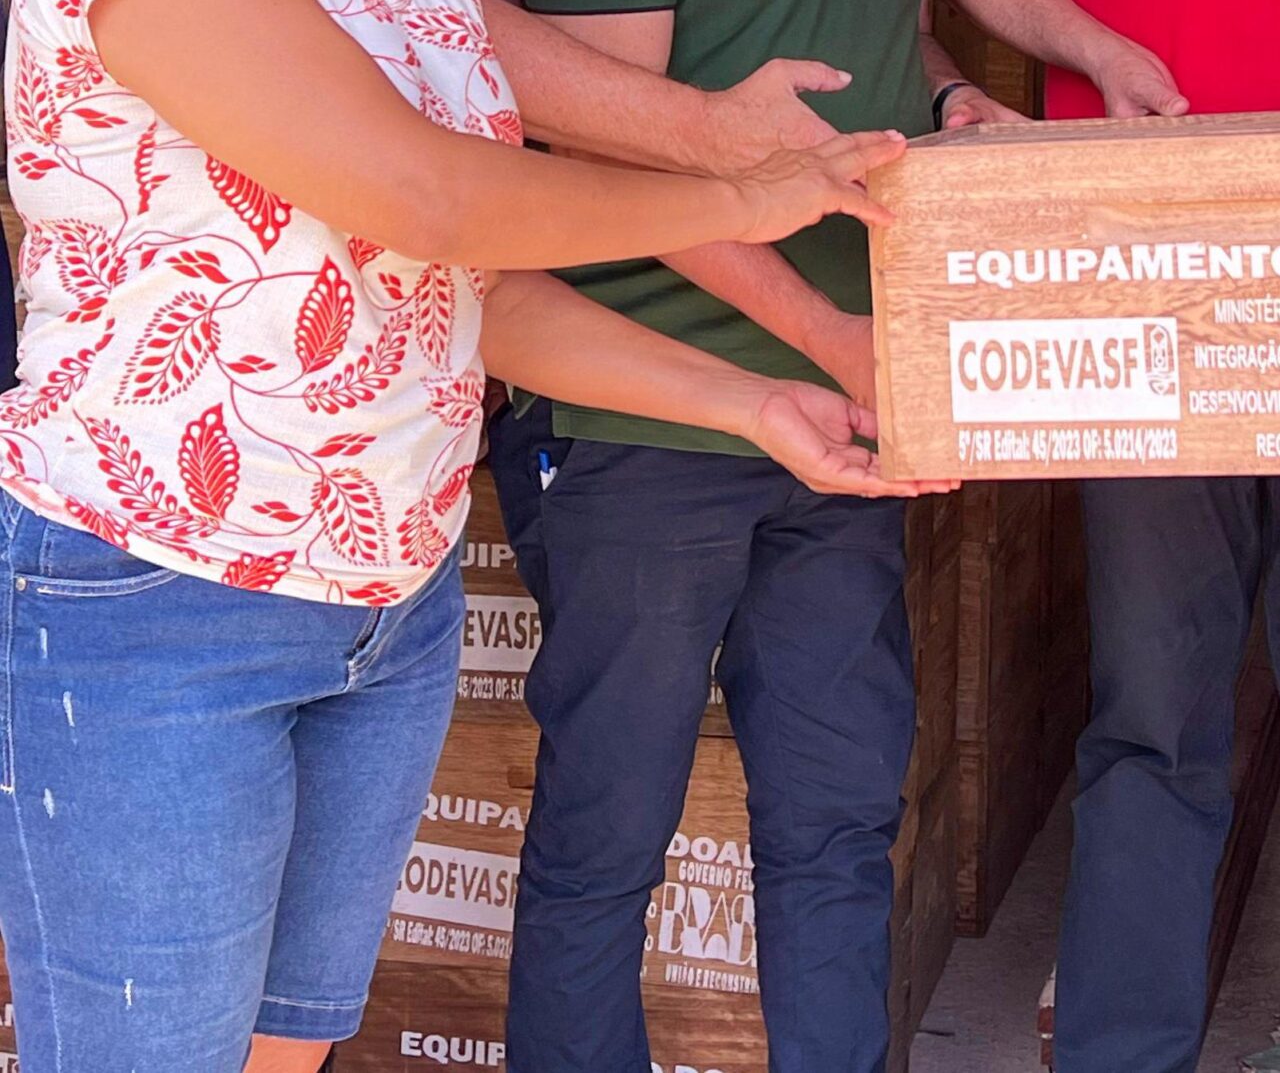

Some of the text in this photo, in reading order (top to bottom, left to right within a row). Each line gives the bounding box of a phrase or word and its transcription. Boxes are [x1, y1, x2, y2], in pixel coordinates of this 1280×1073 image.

[958, 338, 1138, 391] CODEVASF
[1032, 429, 1081, 466] 45/2023
[1104, 427, 1177, 465] 5.0214/2023
[679, 860, 732, 888] GOVERNO
